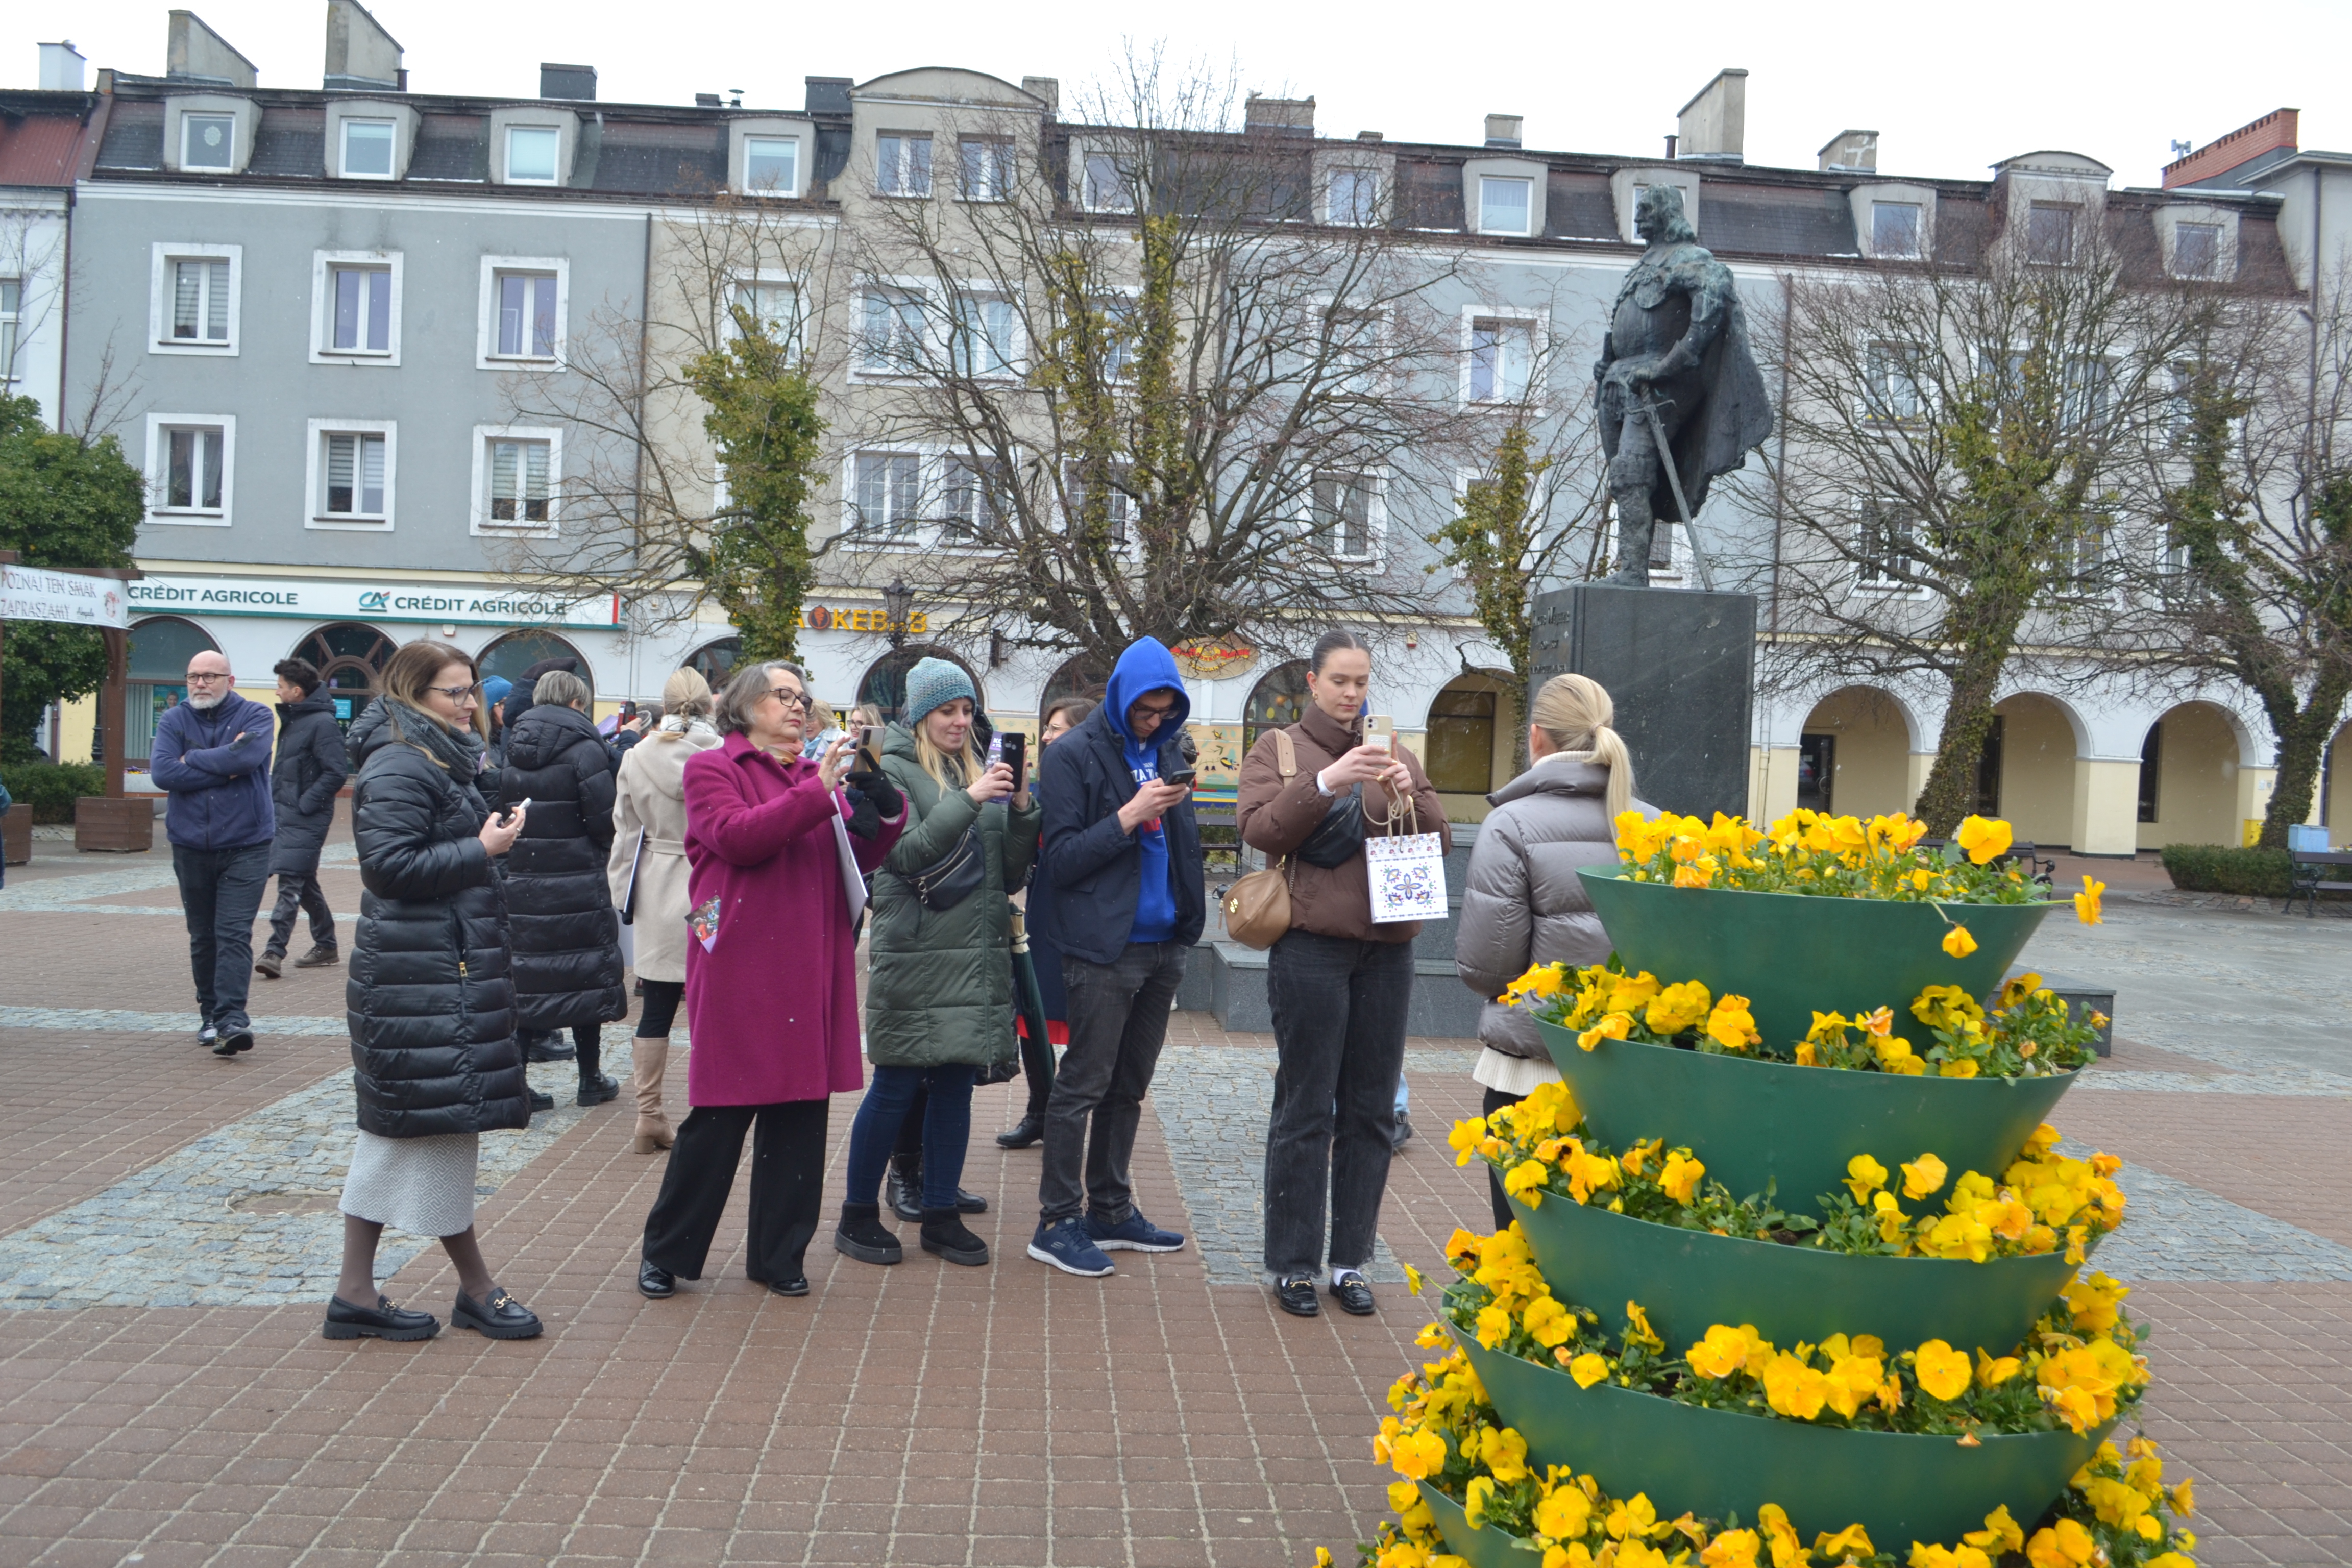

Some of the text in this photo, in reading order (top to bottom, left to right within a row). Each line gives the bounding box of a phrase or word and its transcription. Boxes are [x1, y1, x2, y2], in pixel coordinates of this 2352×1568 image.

[1, 570, 97, 598] POZNAJ TEN SMAK
[128, 585, 298, 605] CRÉDIT AGRICOLE
[0, 598, 70, 619] ZAPRASZAMY
[395, 596, 567, 615] CRÉDIT AGRICOLE
